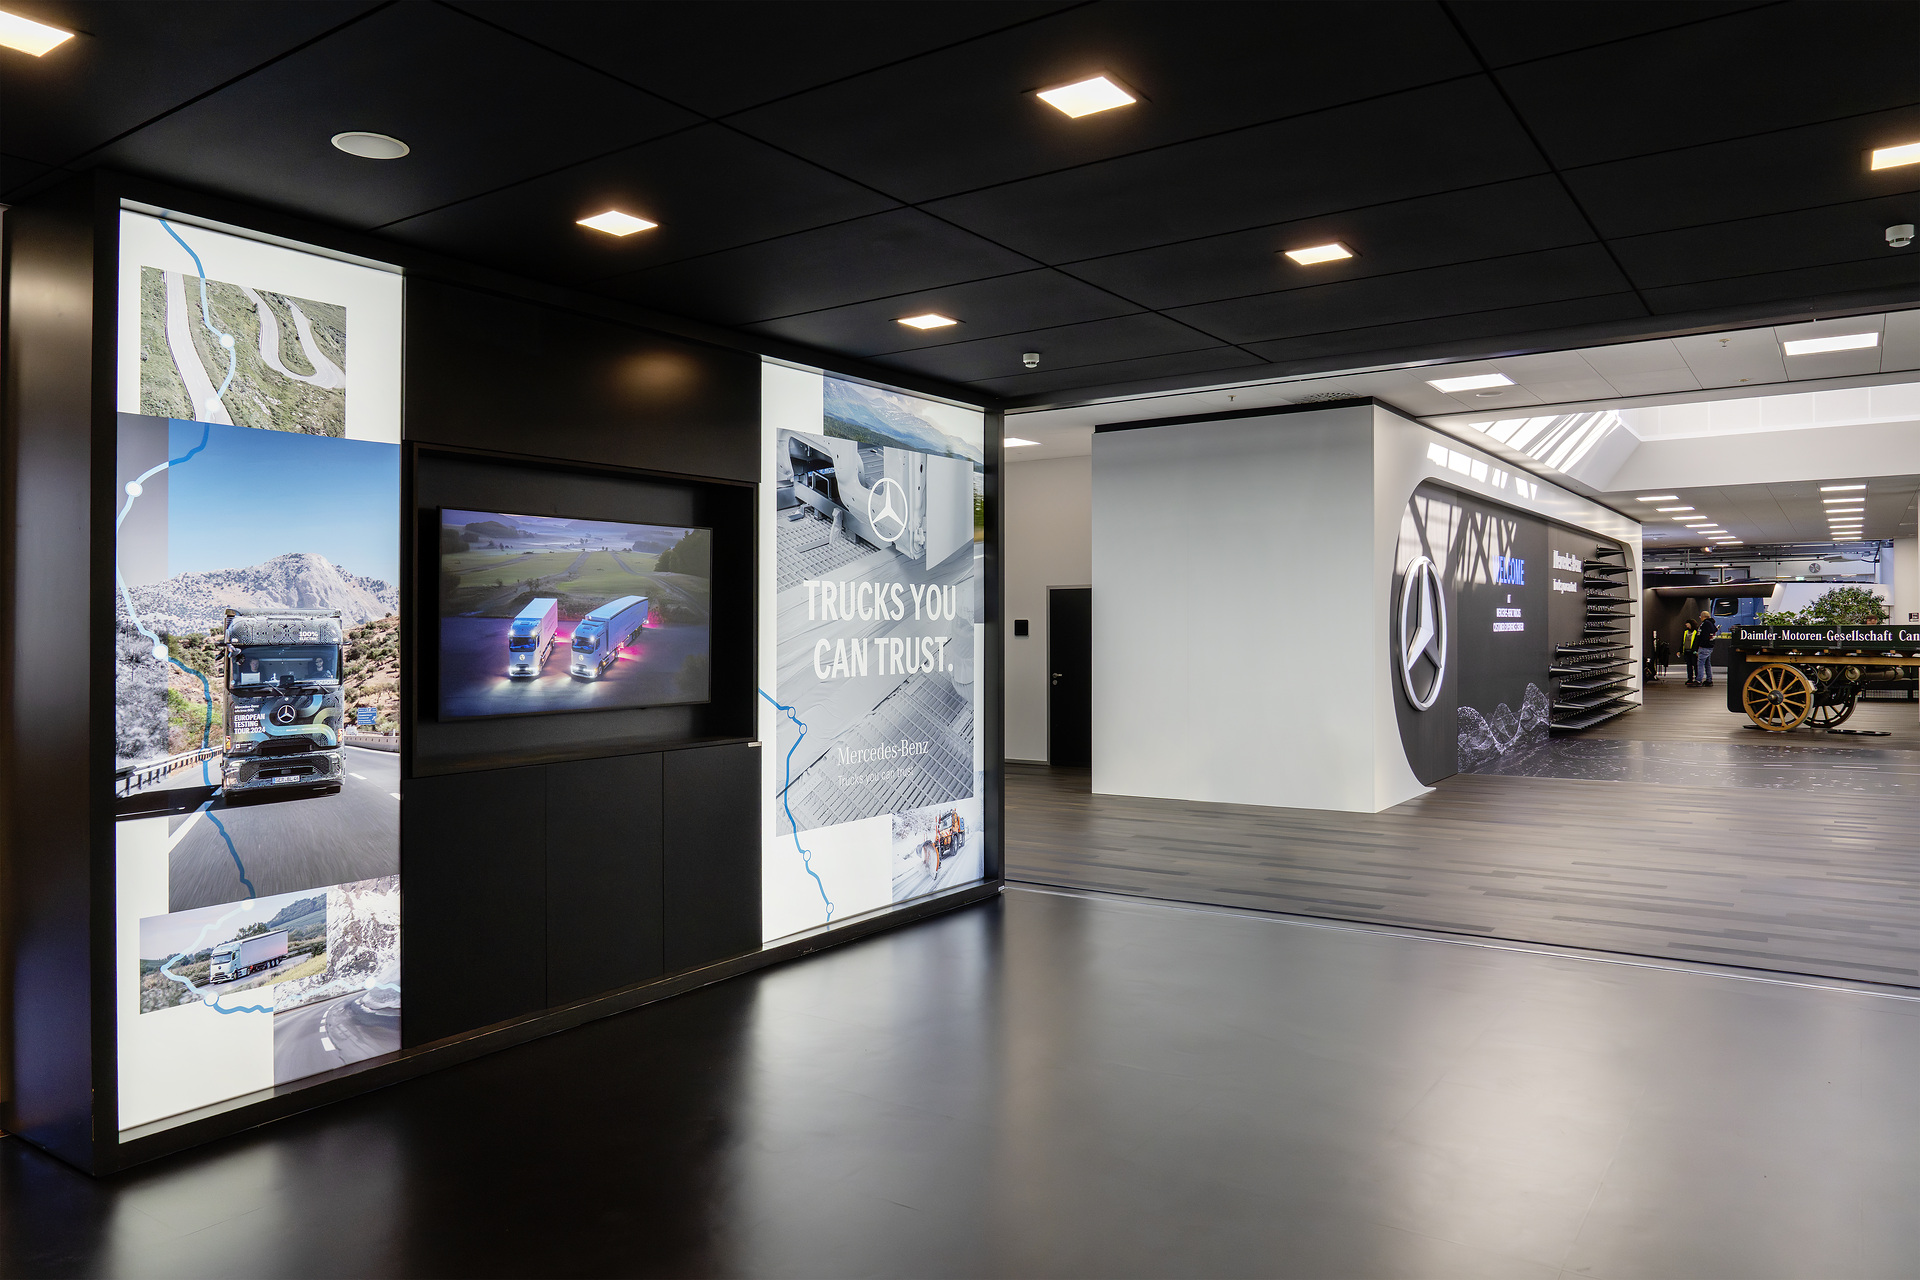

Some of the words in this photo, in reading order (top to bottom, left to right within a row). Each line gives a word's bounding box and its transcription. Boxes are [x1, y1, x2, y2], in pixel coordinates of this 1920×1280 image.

[803, 580, 905, 621] TRUCKS
[909, 583, 957, 621] YOU
[813, 638, 868, 680] CAN
[874, 636, 954, 676] TRUST.
[234, 713, 266, 721] EUROPEAN
[234, 720, 259, 728] TESTING
[250, 726, 266, 734] 2024
[837, 739, 929, 766] Mercedes-Benz
[838, 772, 864, 787] Trucks
[865, 771, 880, 786] you
[881, 768, 895, 780] can
[897, 766, 914, 778] trust
